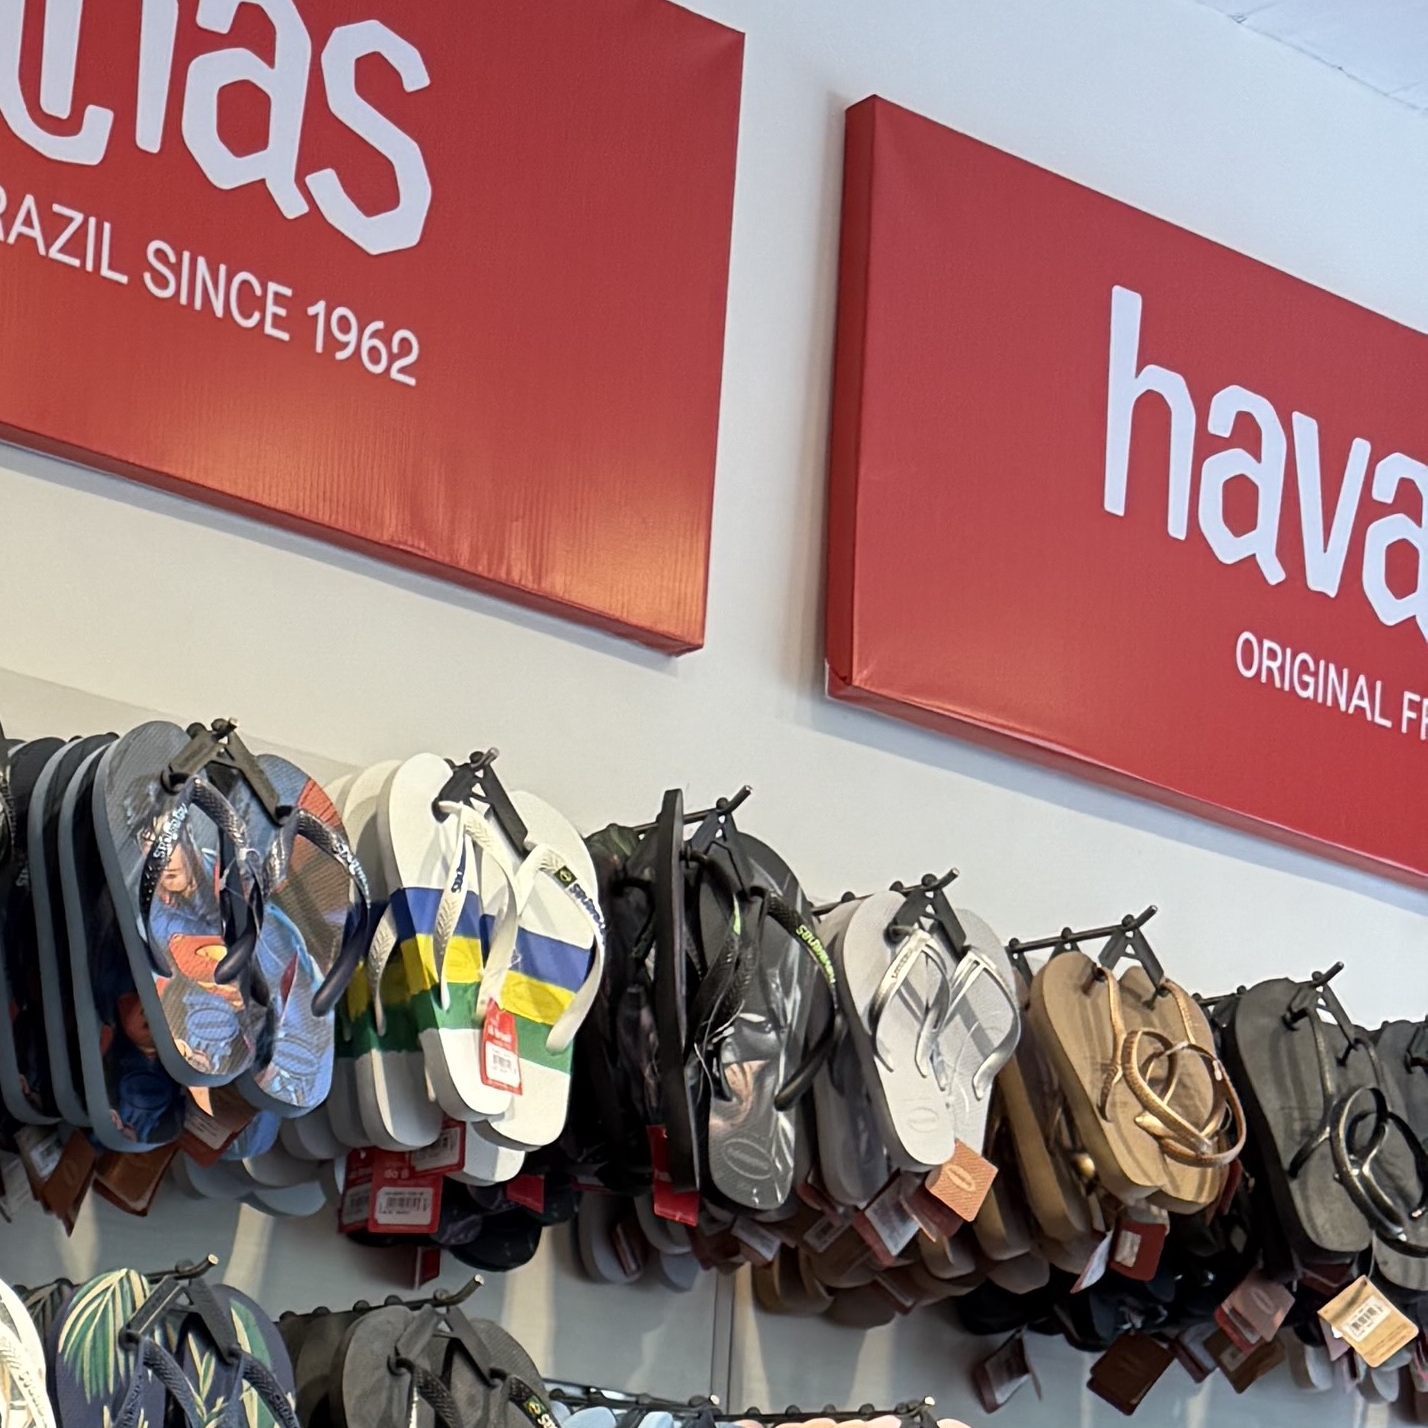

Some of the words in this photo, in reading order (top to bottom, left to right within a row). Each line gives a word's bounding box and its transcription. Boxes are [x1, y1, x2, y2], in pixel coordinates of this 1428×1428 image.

[143, 239, 293, 342] SINCE
[306, 299, 420, 387] 1962
[1235, 630, 1393, 729] ORIGINAL
